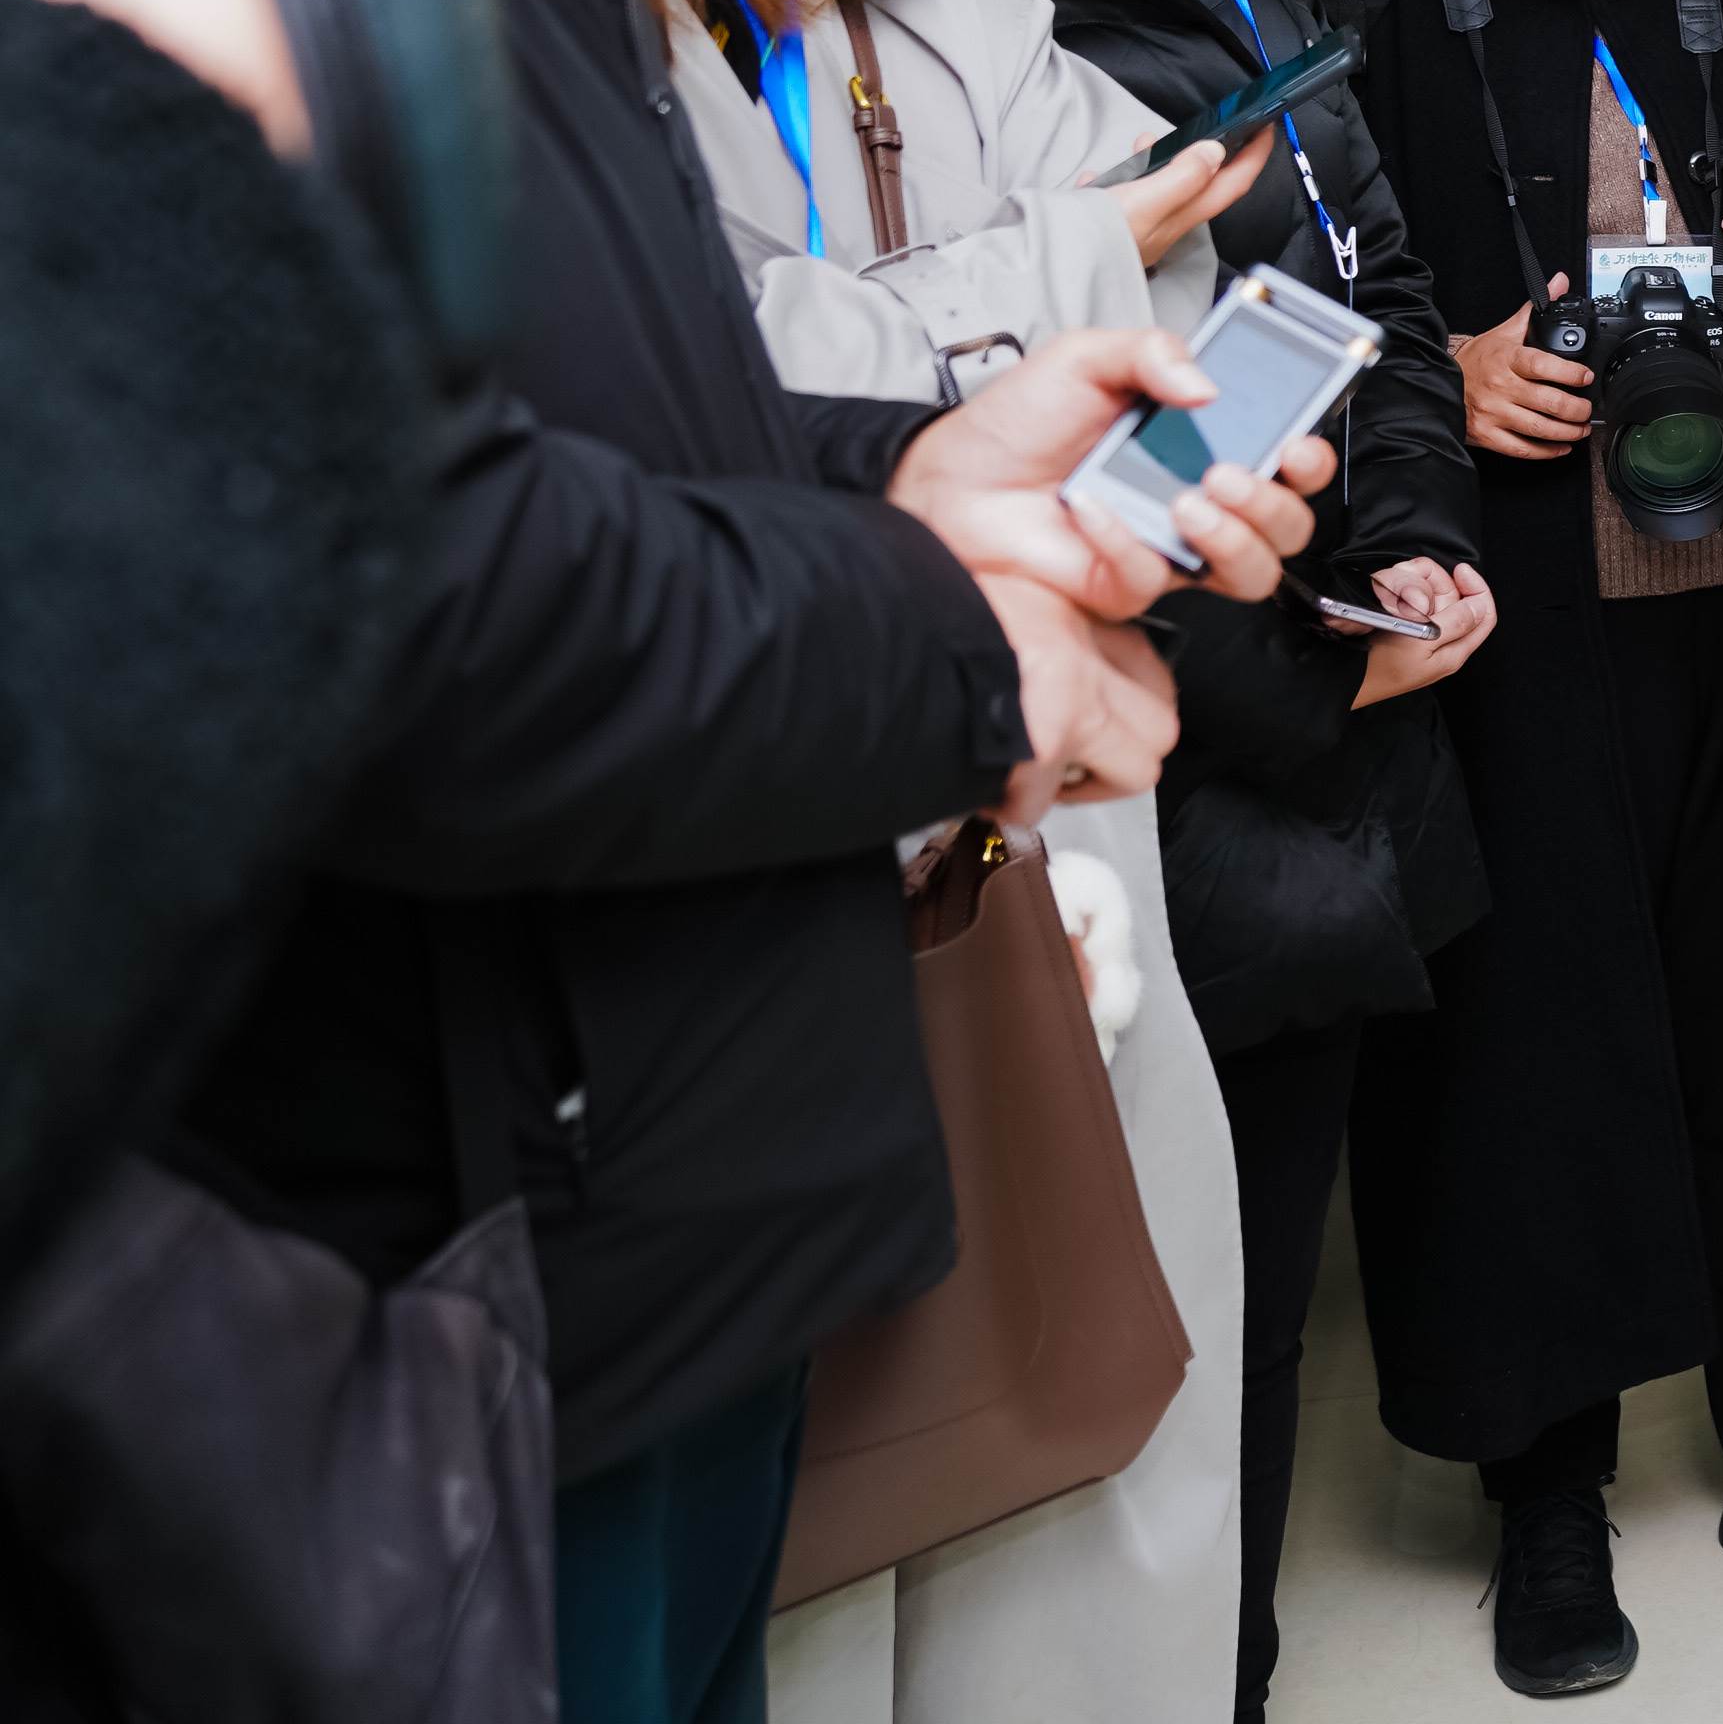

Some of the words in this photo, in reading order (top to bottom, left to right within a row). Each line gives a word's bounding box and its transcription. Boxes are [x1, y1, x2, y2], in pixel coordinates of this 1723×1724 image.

[1644, 311, 1683, 321] Canon
[1706, 327, 1723, 337] EOS
[1709, 338, 1721, 347] R6
